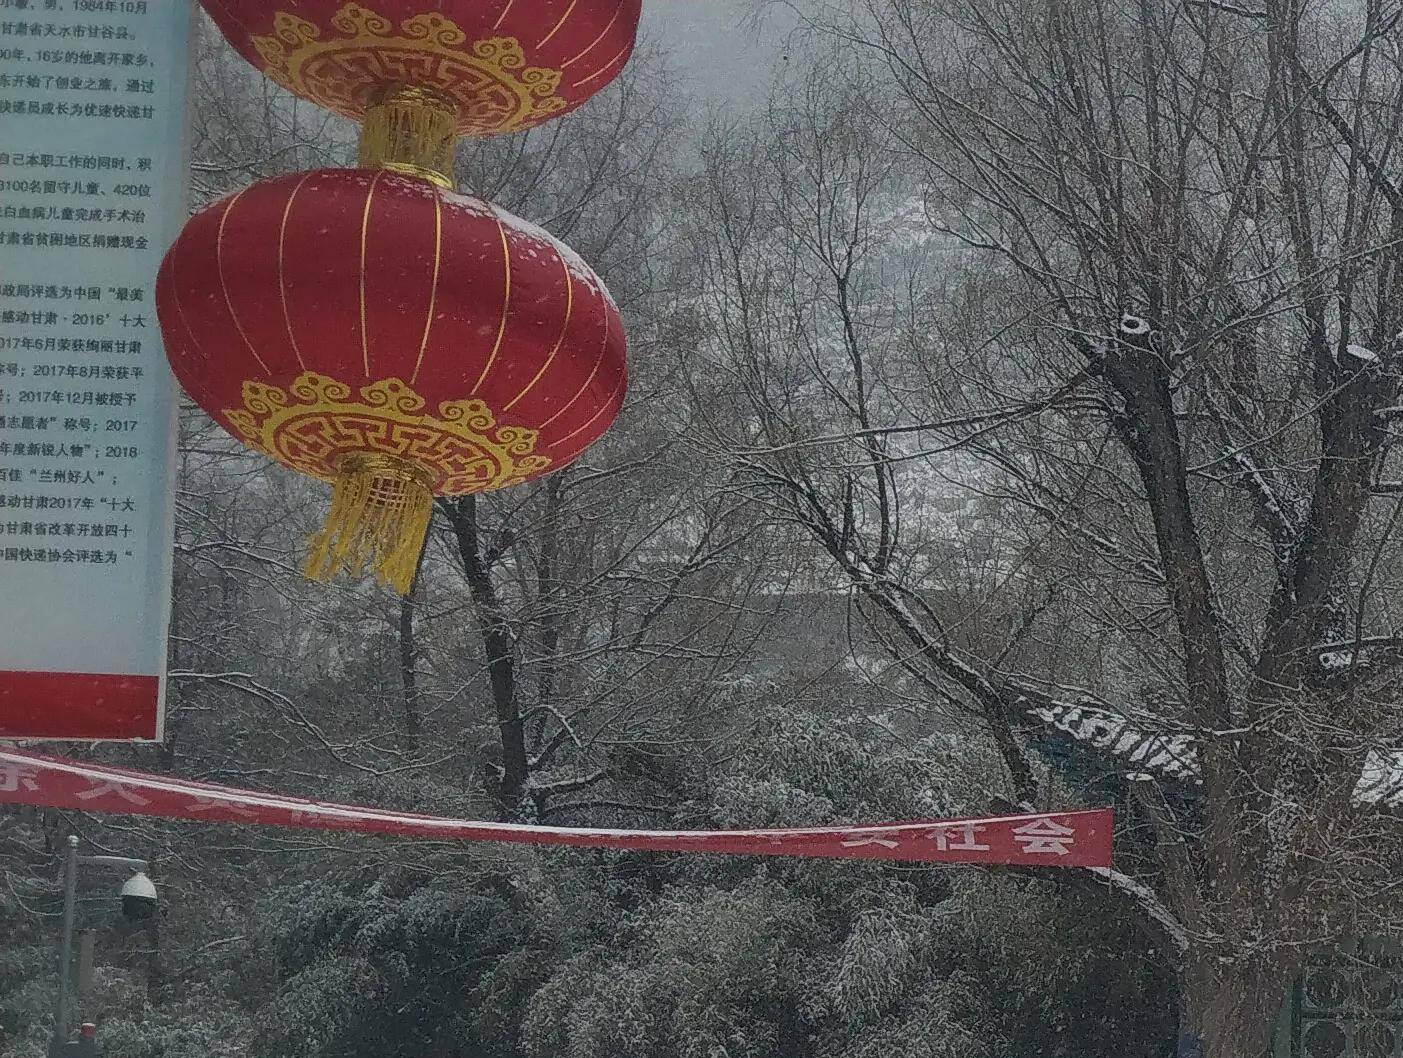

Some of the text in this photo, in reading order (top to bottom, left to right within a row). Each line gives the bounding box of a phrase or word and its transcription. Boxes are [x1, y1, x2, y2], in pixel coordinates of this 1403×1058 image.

[0, 206, 145, 223] 白血病儿童完成手术治
[0, 389, 137, 406] ；2017年12月被授予
